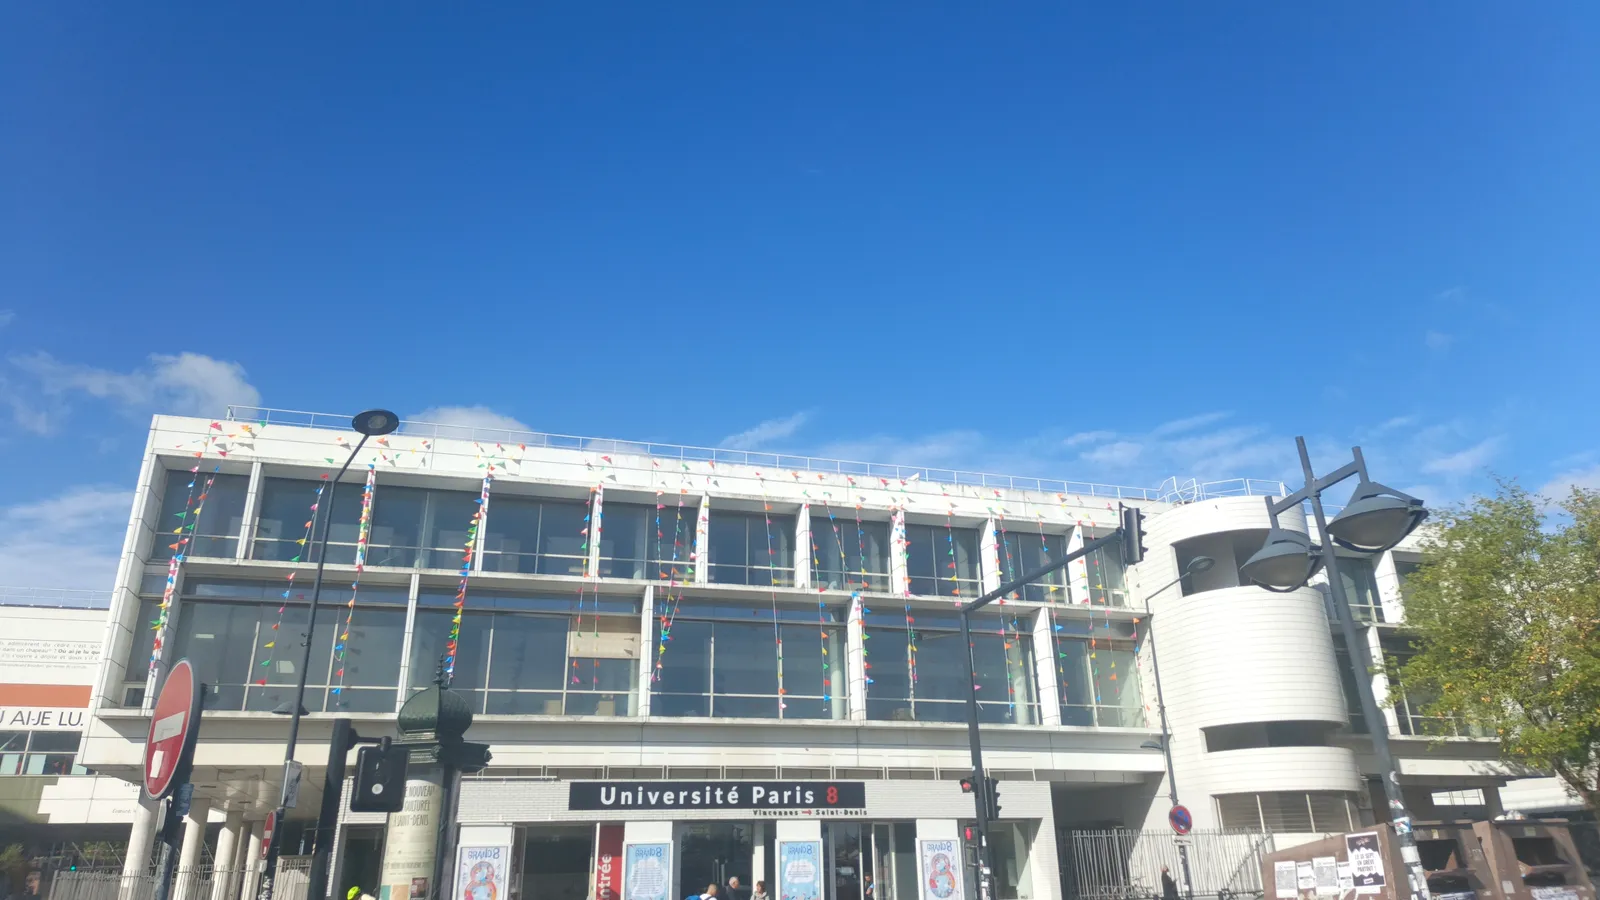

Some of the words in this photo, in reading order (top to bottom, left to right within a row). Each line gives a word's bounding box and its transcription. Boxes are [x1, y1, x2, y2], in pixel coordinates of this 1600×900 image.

[9, 711, 52, 726] AI-JE
[58, 712, 84, 726] LU.
[600, 786, 739, 805] Université
[752, 786, 814, 804] Paris
[826, 786, 838, 804] 8
